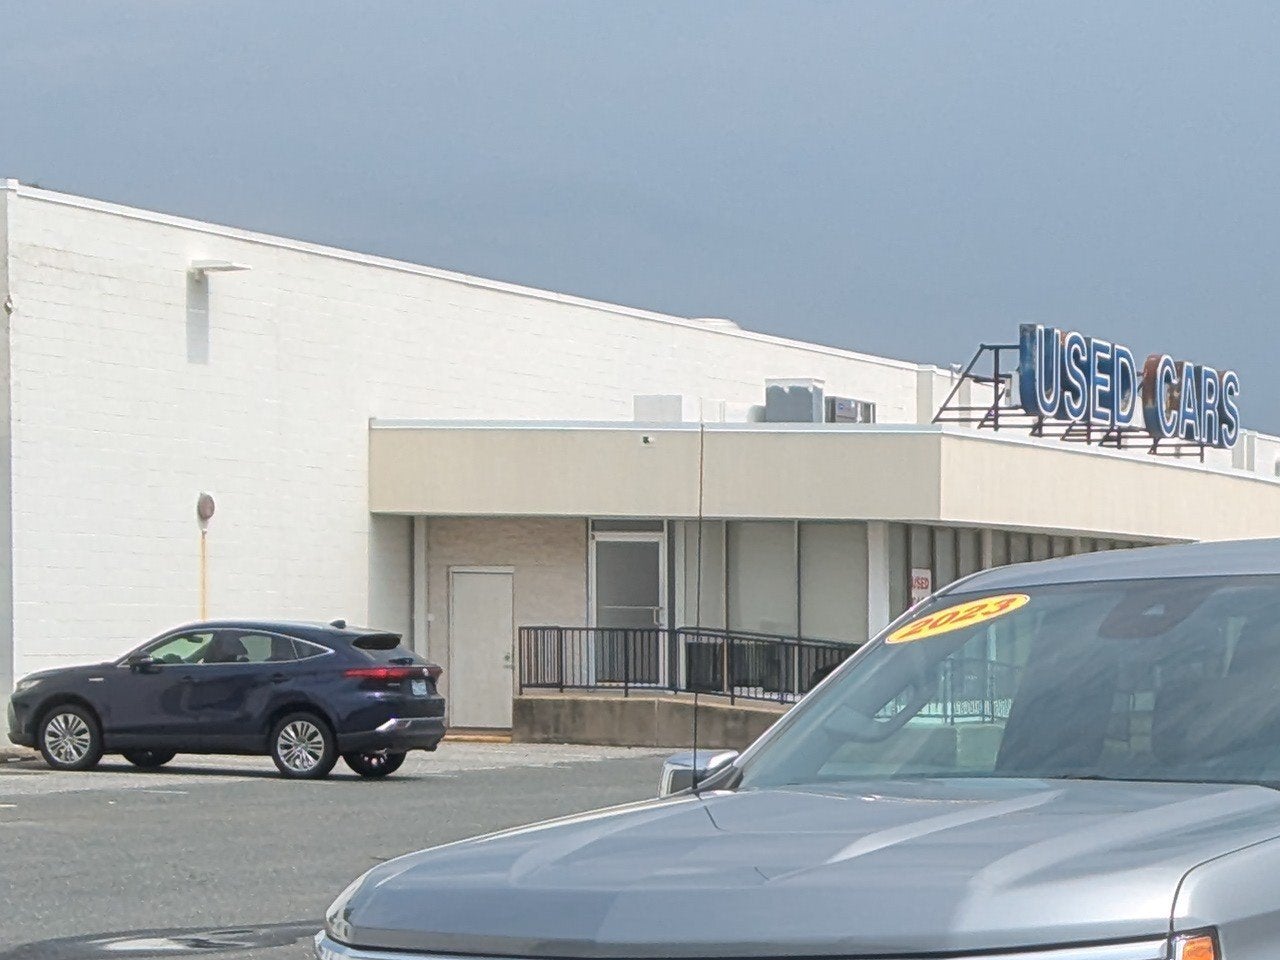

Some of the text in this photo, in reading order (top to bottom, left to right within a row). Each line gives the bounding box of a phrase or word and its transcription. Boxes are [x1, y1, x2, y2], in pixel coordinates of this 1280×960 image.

[1033, 323, 1241, 449] USED CARS
[898, 596, 1019, 641] 2023
